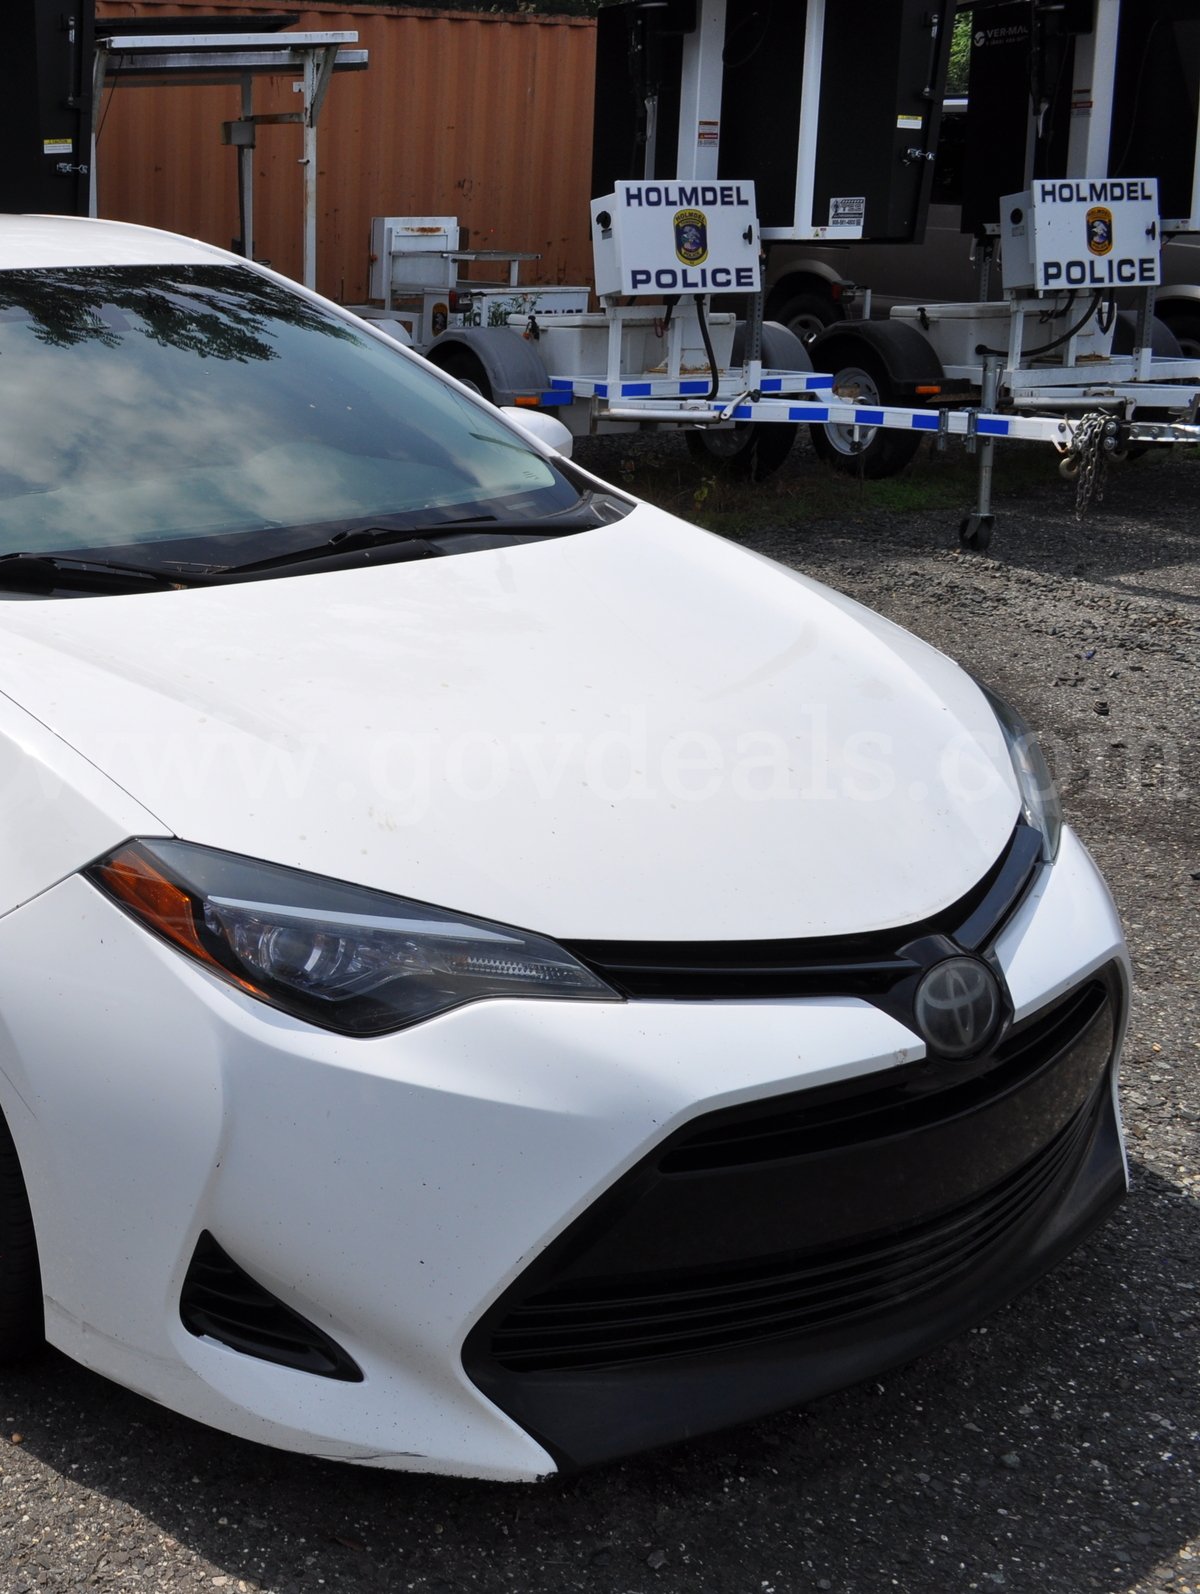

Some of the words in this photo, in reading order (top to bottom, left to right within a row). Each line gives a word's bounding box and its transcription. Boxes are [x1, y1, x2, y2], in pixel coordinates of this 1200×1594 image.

[625, 186, 750, 207] HOLMDEL
[1041, 182, 1153, 203] HOLMDEL
[675, 211, 706, 222] HOLMDEL
[631, 267, 755, 290] POLICE
[1044, 258, 1156, 286] POLICE
